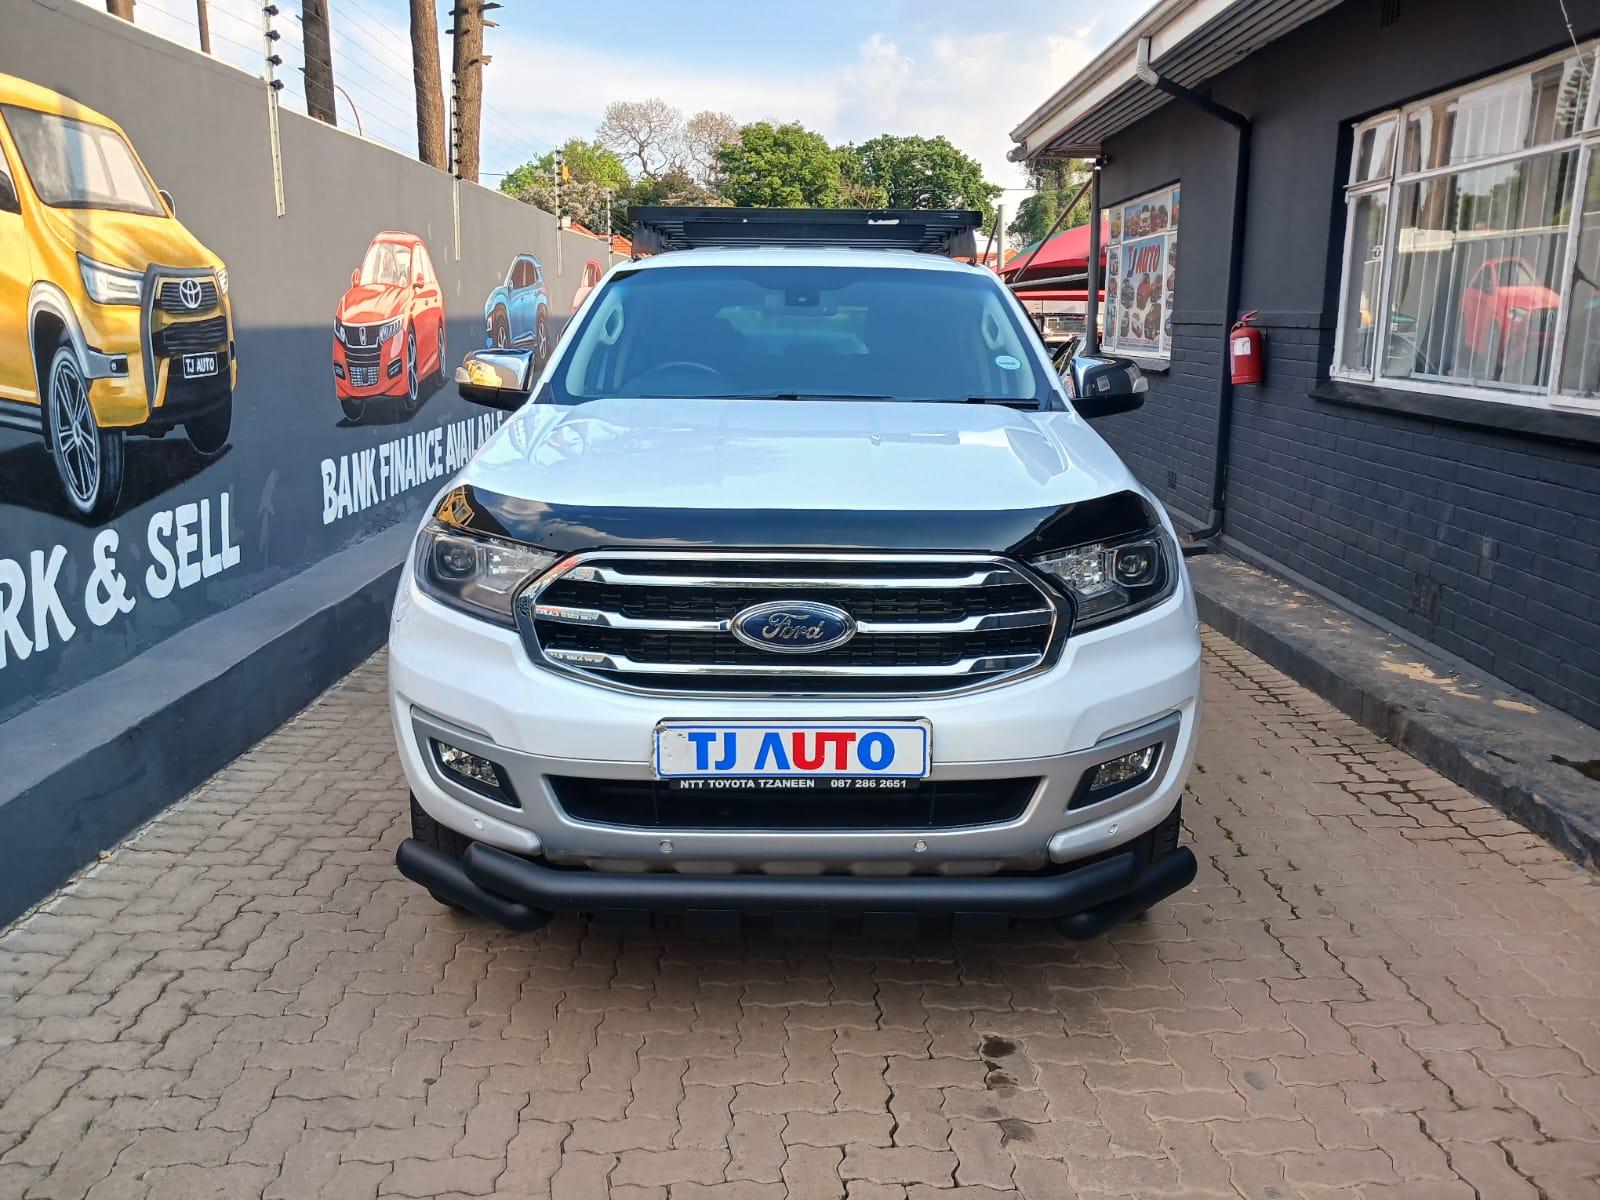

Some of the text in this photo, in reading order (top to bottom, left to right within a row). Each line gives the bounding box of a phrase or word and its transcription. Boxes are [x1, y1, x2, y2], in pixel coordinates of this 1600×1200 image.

[1135, 244, 1160, 274] AUTO
[185, 357, 214, 373] TJ AUTO
[321, 447, 379, 525] BANK
[379, 427, 443, 501] FINANCE
[85, 528, 136, 626] &
[145, 492, 241, 599] SELL
[762, 612, 825, 639] Ford
[688, 731, 895, 770] TJ AUTO
[680, 779, 907, 789] NTT TOYOTA TZANEEN 087 286 2651
